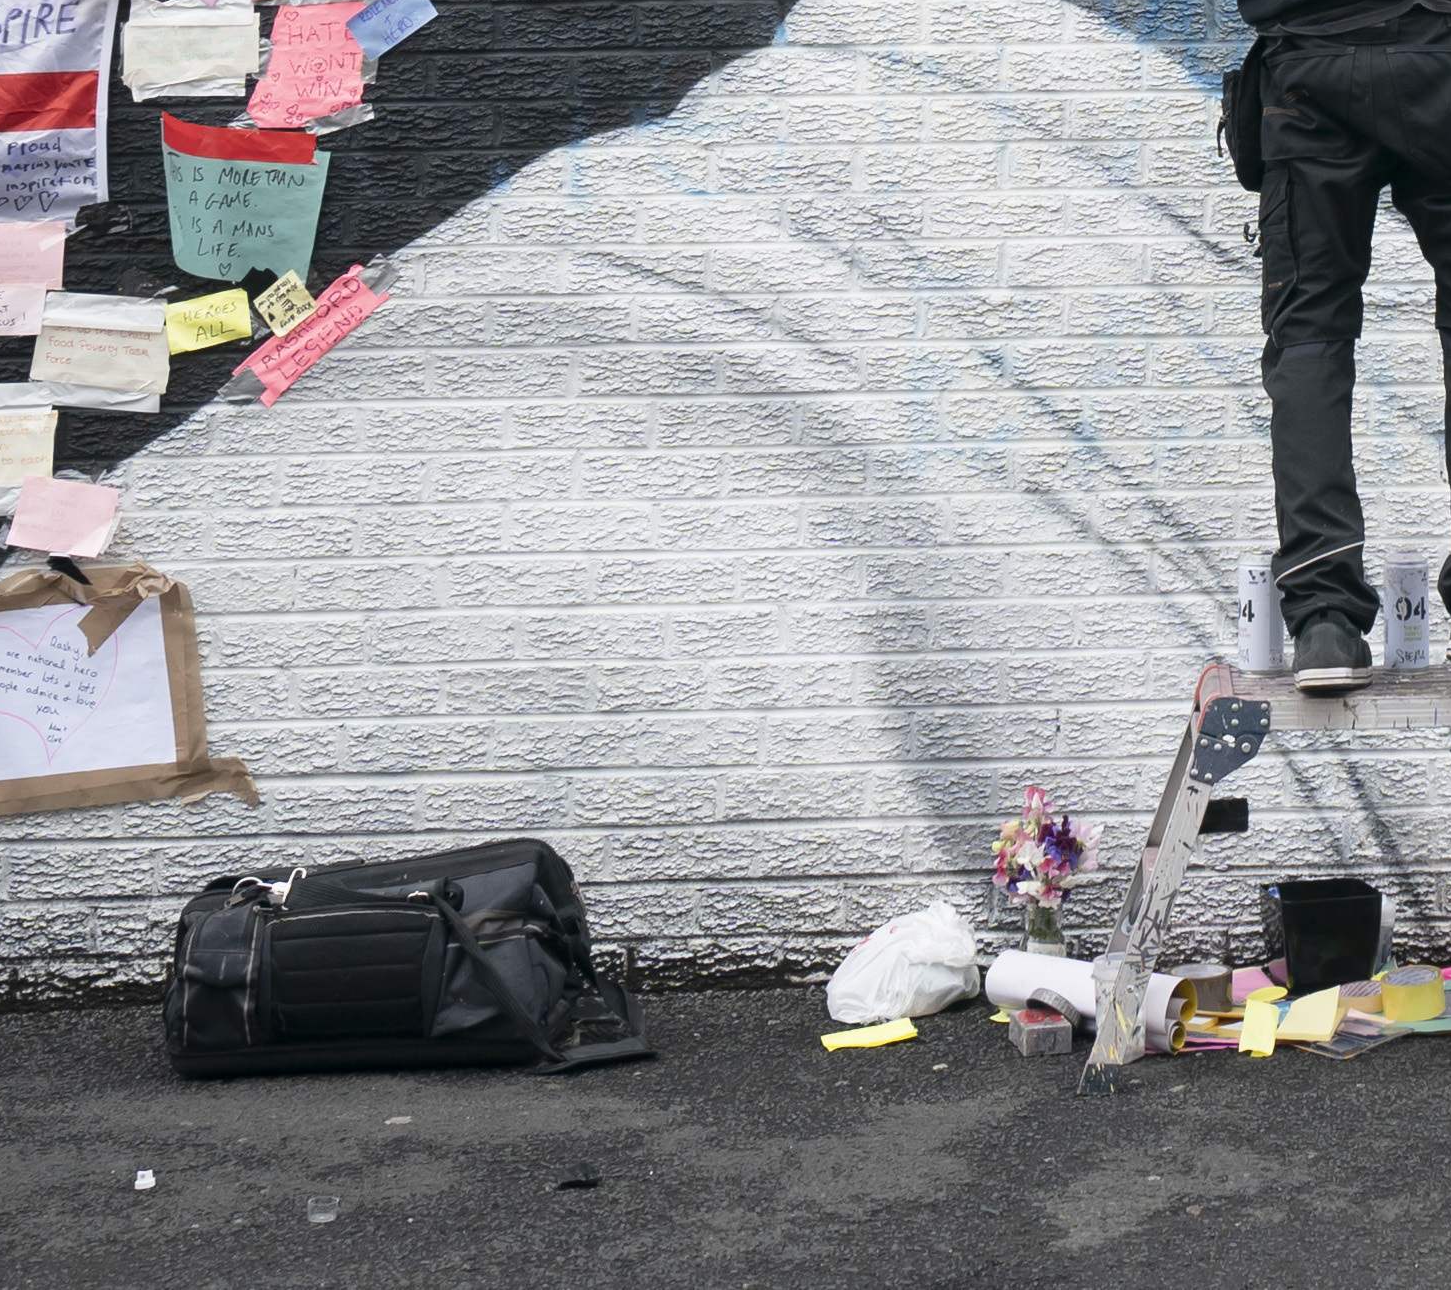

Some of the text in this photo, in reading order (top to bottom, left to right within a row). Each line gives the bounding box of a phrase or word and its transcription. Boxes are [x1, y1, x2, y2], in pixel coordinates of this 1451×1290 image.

[193, 166, 261, 186] IS MORE
[183, 301, 237, 322] HEROES
[195, 322, 236, 342] ALL
[1395, 595, 1426, 620] 94
